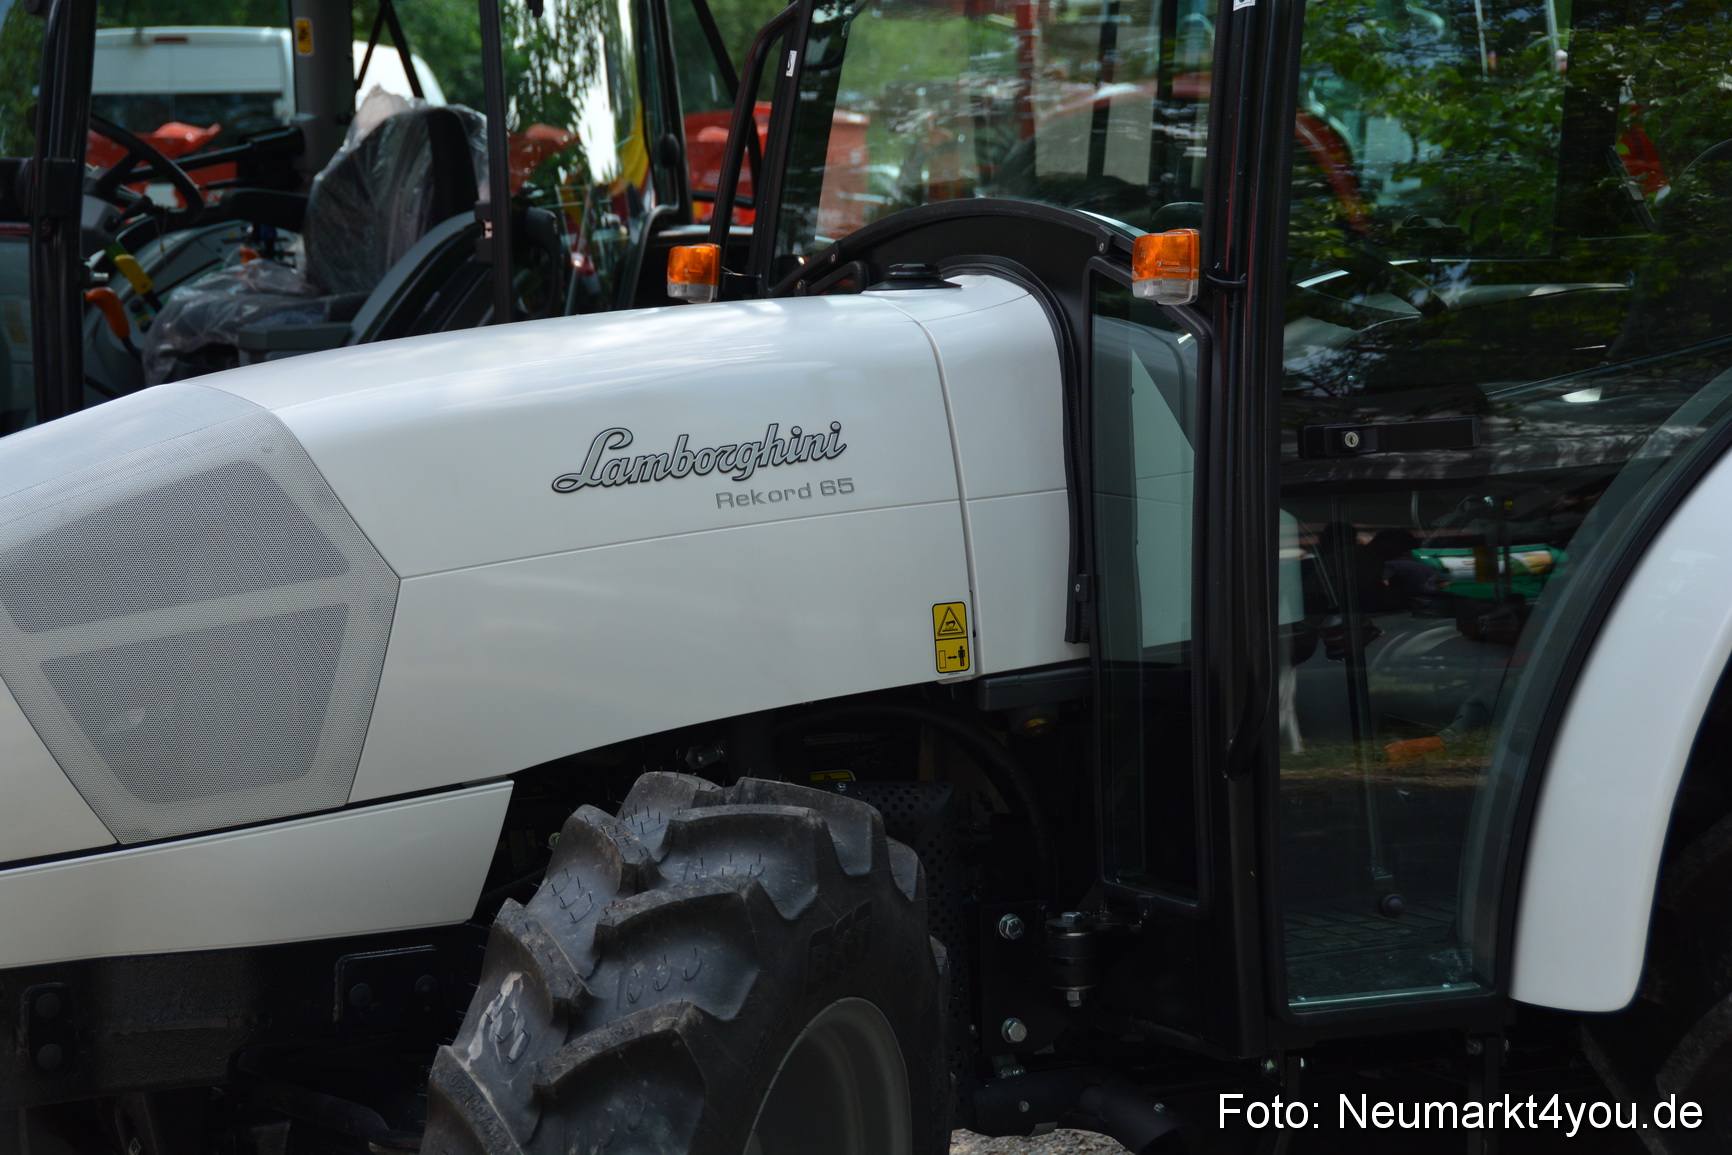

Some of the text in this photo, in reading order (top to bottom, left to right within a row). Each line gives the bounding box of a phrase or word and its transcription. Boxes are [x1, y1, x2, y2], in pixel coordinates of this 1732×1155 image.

[551, 421, 847, 493] Lamborghini
[715, 477, 855, 510] Rekord 65
